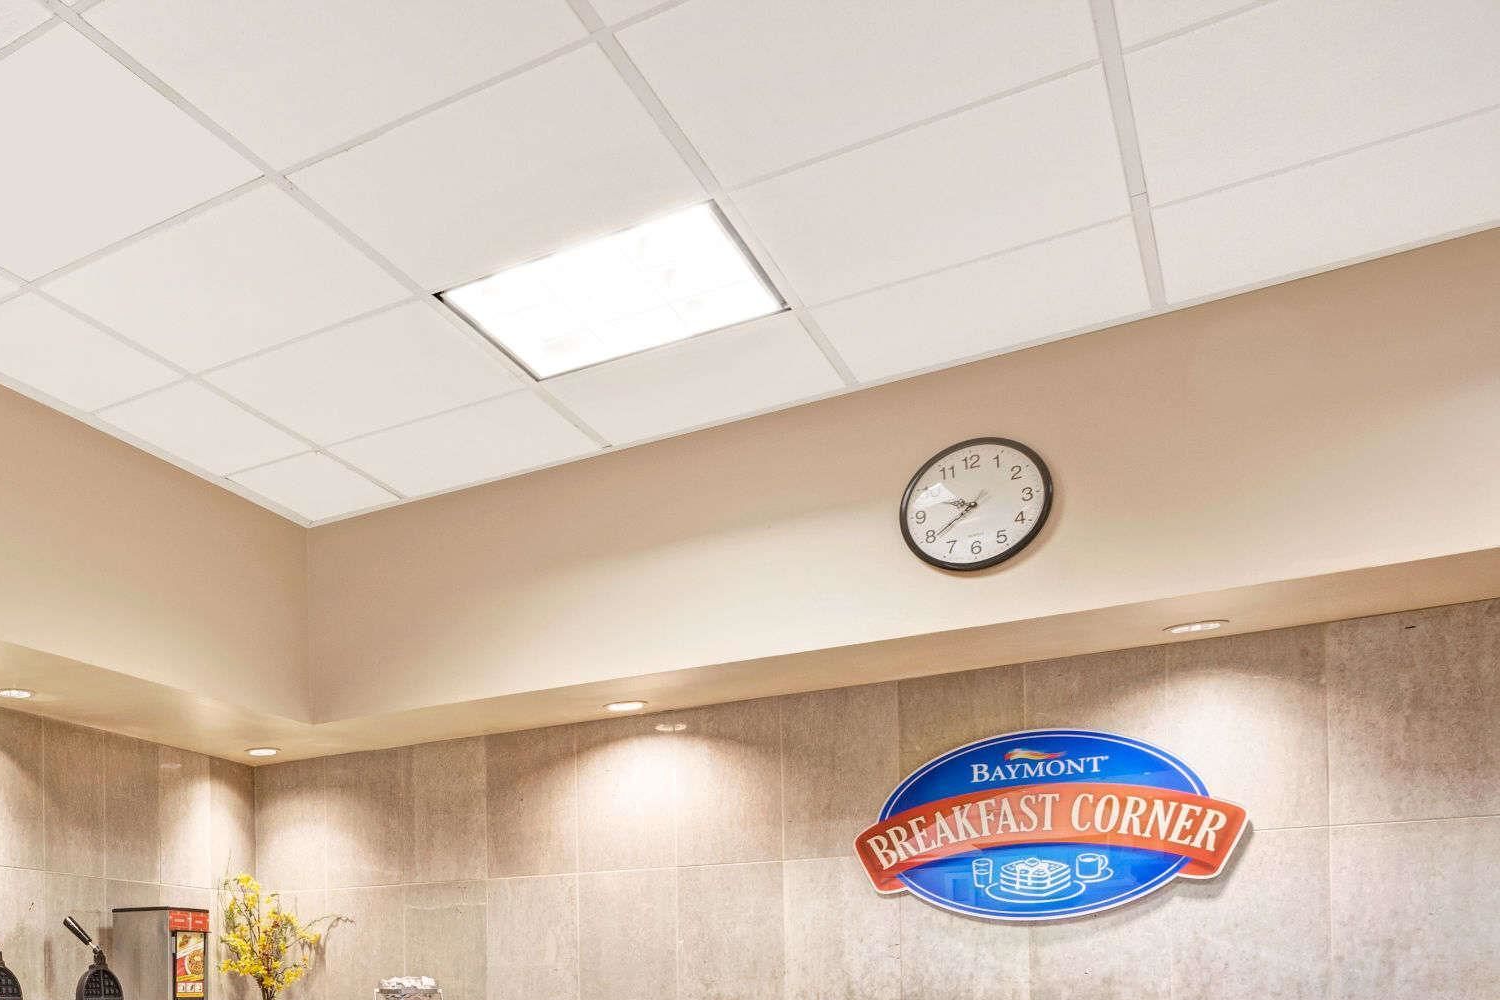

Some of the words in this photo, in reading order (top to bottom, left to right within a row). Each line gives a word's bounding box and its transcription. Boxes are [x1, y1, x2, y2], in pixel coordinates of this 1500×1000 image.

[962, 454, 981, 470] 12
[993, 454, 1001, 468] 1
[939, 466, 956, 480] 11
[1010, 465, 1023, 480] 2
[1021, 486, 1034, 501] 3
[915, 510, 926, 524] 9
[1014, 510, 1026, 524] 4
[925, 529, 936, 543] 8
[996, 529, 1008, 543] 5
[946, 540, 957, 554] 7
[971, 540, 982, 554] 6
[970, 756, 1106, 783] BAYMONT
[866, 793, 1060, 870] BREAKFAST
[1071, 793, 1228, 852] CORNER
